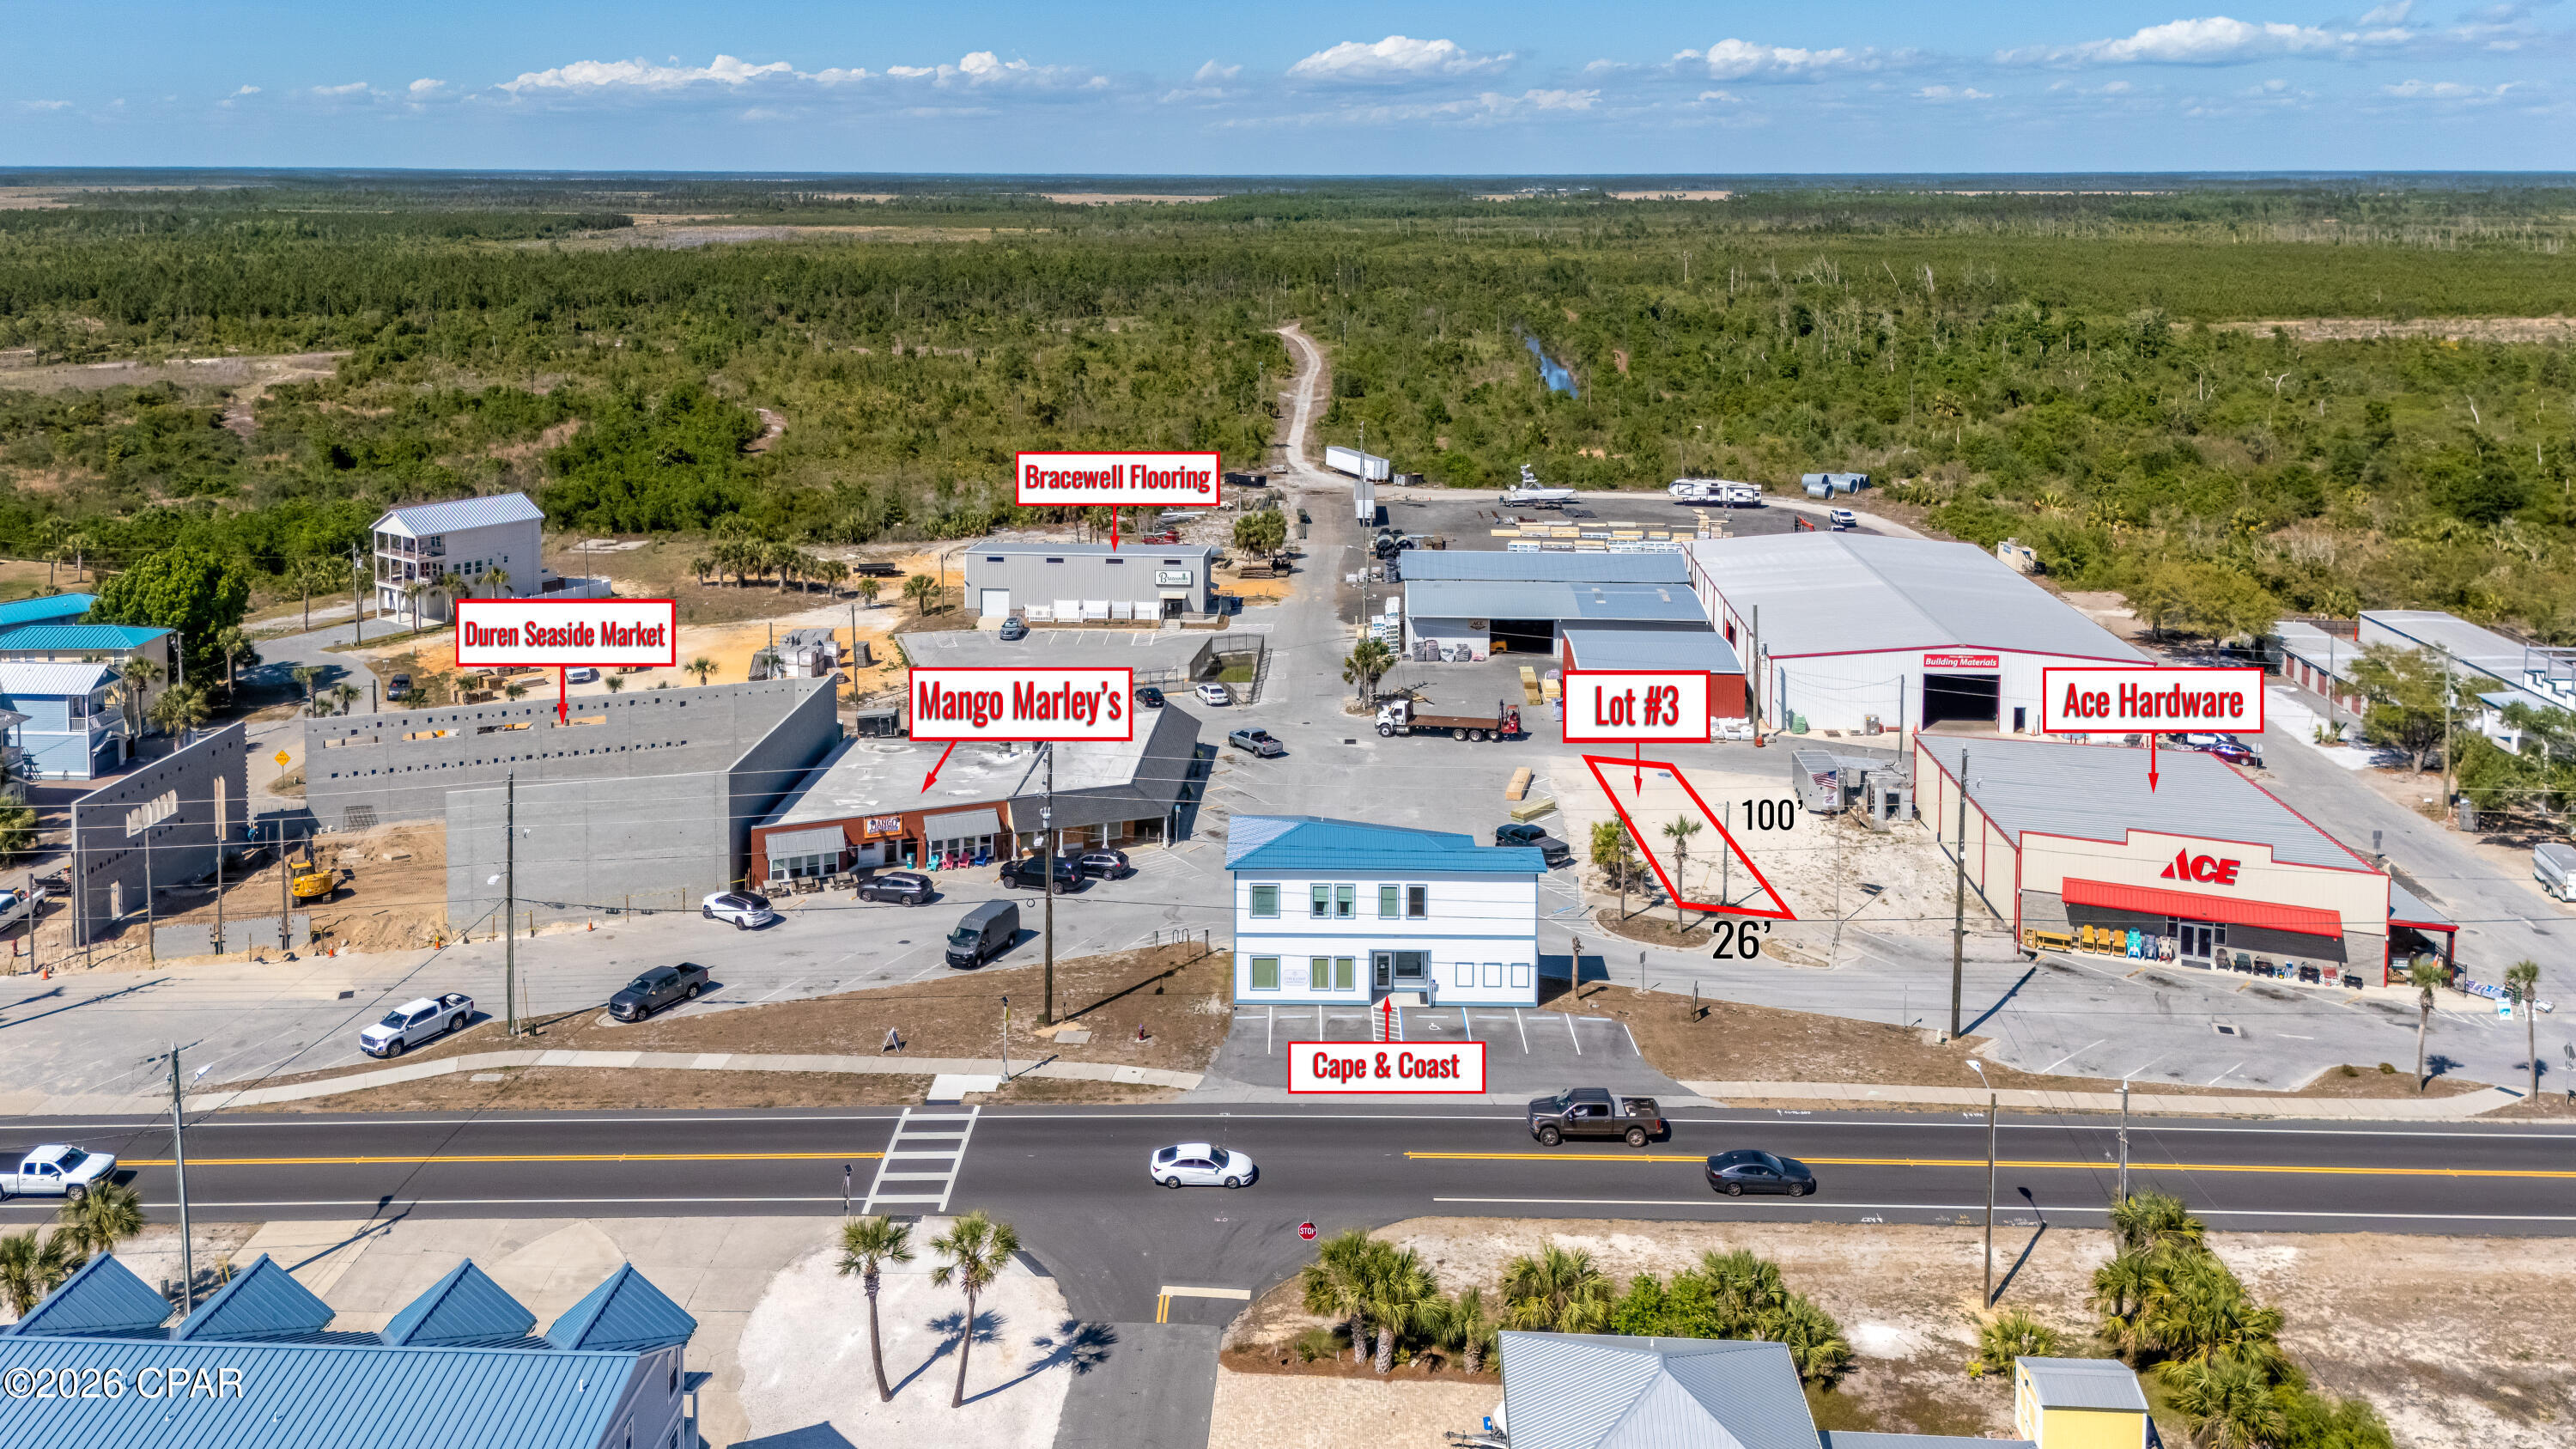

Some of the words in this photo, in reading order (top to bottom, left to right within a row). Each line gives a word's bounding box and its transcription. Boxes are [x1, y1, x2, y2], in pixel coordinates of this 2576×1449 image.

[1925, 657, 1958, 667] Building
[1959, 658, 1997, 667] Materials
[871, 818, 898, 831] MANGO
[2160, 847, 2241, 886] ACE
[1299, 1227, 1316, 1235] STOP
